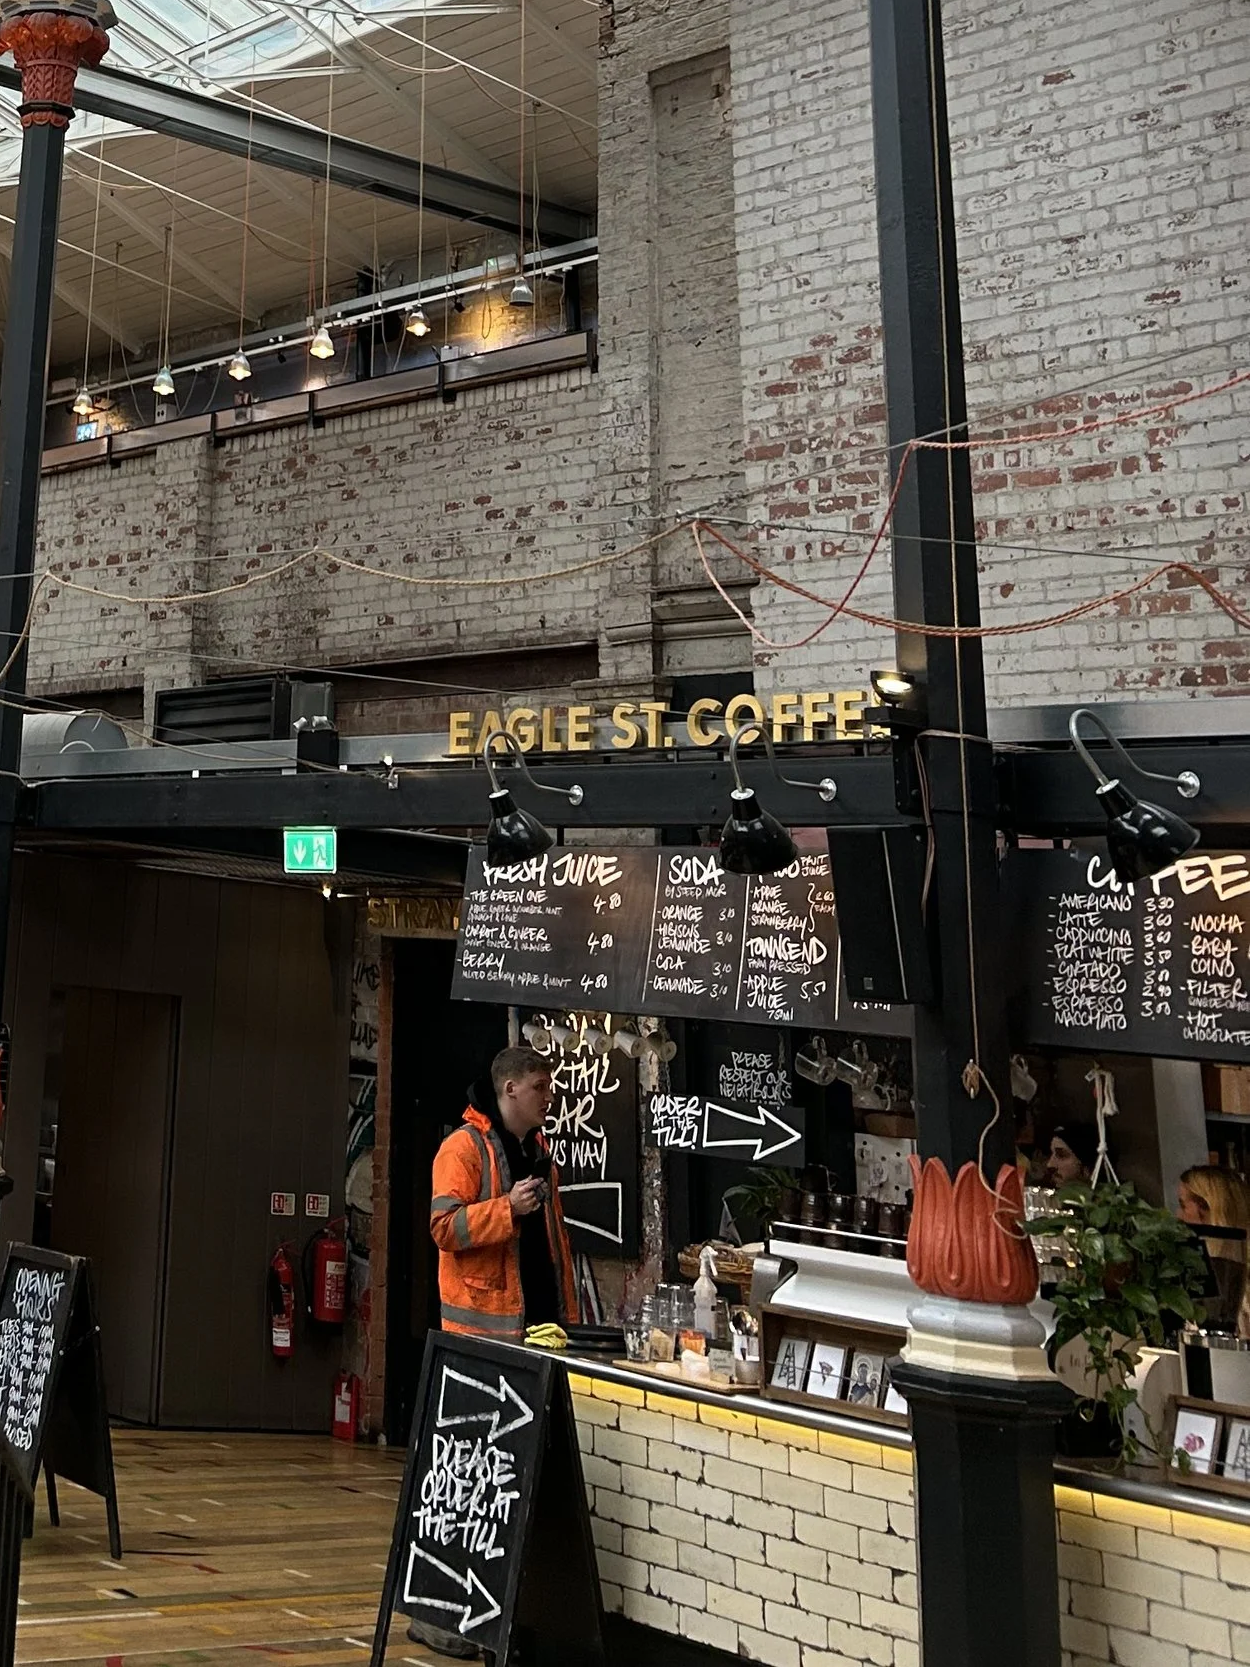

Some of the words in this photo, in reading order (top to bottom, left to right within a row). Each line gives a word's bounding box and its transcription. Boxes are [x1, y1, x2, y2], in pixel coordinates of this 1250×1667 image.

[449, 706, 595, 754] EAGLE
[612, 702, 674, 749] ST.
[483, 853, 548, 887] FRESH
[552, 853, 623, 887] JUICE
[669, 854, 725, 886] SODA
[800, 854, 828, 867] FRUIT
[801, 865, 830, 877] JUICE
[470, 890, 489, 902] THE
[490, 888, 524, 903] GREEN
[526, 890, 548, 902] ONE
[753, 885, 782, 899] APPLE
[366, 897, 461, 930] STRAY
[662, 905, 703, 922] ORANGE
[751, 900, 791, 916] ORANGE
[1058, 893, 1132, 912] AMERICANO
[1144, 897, 1174, 914] 3.30
[751, 914, 807, 940] STRAWBERRY
[1058, 911, 1103, 926] LATTE
[1190, 914, 1245, 934] MOCHA
[465, 924, 499, 939] CARROT
[508, 926, 548, 941] GINGER
[658, 922, 700, 939] HIBISCUS
[1056, 925, 1132, 946] CAPPUCCINO
[658, 936, 711, 954] LEMONADE
[746, 934, 827, 965] TOWNSEND
[1191, 935, 1238, 963] BABY
[462, 949, 505, 974] BERRY
[655, 953, 686, 970] COLA
[1054, 944, 1090, 961] FLAT
[1089, 946, 1135, 965] WHITE
[1143, 949, 1172, 968] 3.50
[748, 958, 767, 971] FARM
[768, 958, 811, 975] PRESSED
[1058, 960, 1121, 979] CORTADO
[549, 977, 572, 987] MINT
[653, 975, 707, 995] LEMONADE
[746, 975, 788, 992] APPLE
[1053, 977, 1126, 998] ESPRESSO
[1187, 978, 1248, 1003] FILTER
[747, 990, 787, 1010] JUICE
[1052, 994, 1124, 1013] ESPRESSO
[1055, 1011, 1127, 1031] MACCHIATO
[1187, 1010, 1222, 1029] HOT
[1183, 1026, 1250, 1045] CHOCOLATE
[731, 1051, 773, 1069] PLEASE
[720, 1065, 764, 1085] RESPECT
[766, 1069, 790, 1086] OUR
[719, 1082, 792, 1107] NEIGHBOURS
[651, 1094, 702, 1116] ORDER
[653, 1115, 668, 1127] AT
[669, 1116, 696, 1133] THE
[651, 1126, 699, 1150] TILL!
[571, 1135, 607, 1180] WAY
[15, 1267, 65, 1302] OPENING
[14, 1293, 55, 1322] HOURS
[0, 1318, 20, 1334] TUES
[433, 1434, 516, 1486] PLEASE
[421, 1469, 487, 1518] ORDER
[490, 1486, 520, 1524] AT
[412, 1504, 458, 1546] THE
[457, 1516, 505, 1560] TILL
